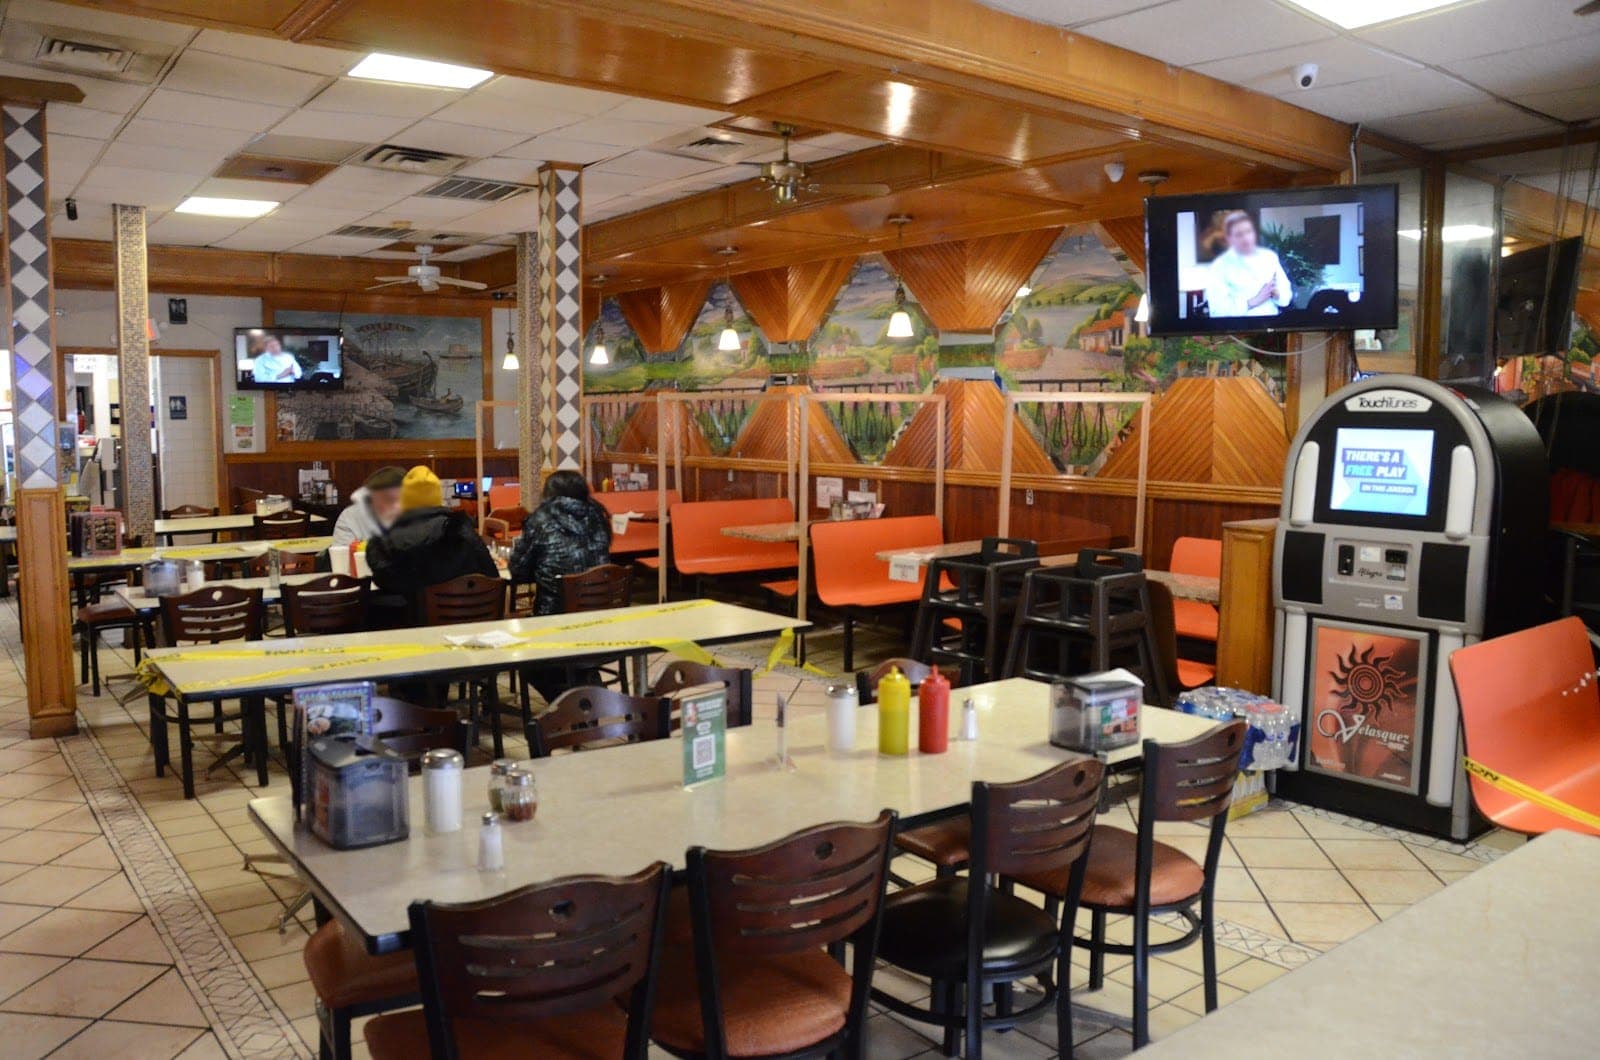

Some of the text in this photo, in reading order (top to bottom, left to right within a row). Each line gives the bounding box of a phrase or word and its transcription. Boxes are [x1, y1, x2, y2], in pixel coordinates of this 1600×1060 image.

[1359, 397, 1418, 409] TouchTunes
[1345, 451, 1400, 463] THERE'S A
[1345, 464, 1406, 478] FREE PLAY
[1317, 709, 1410, 744] Velasquez
